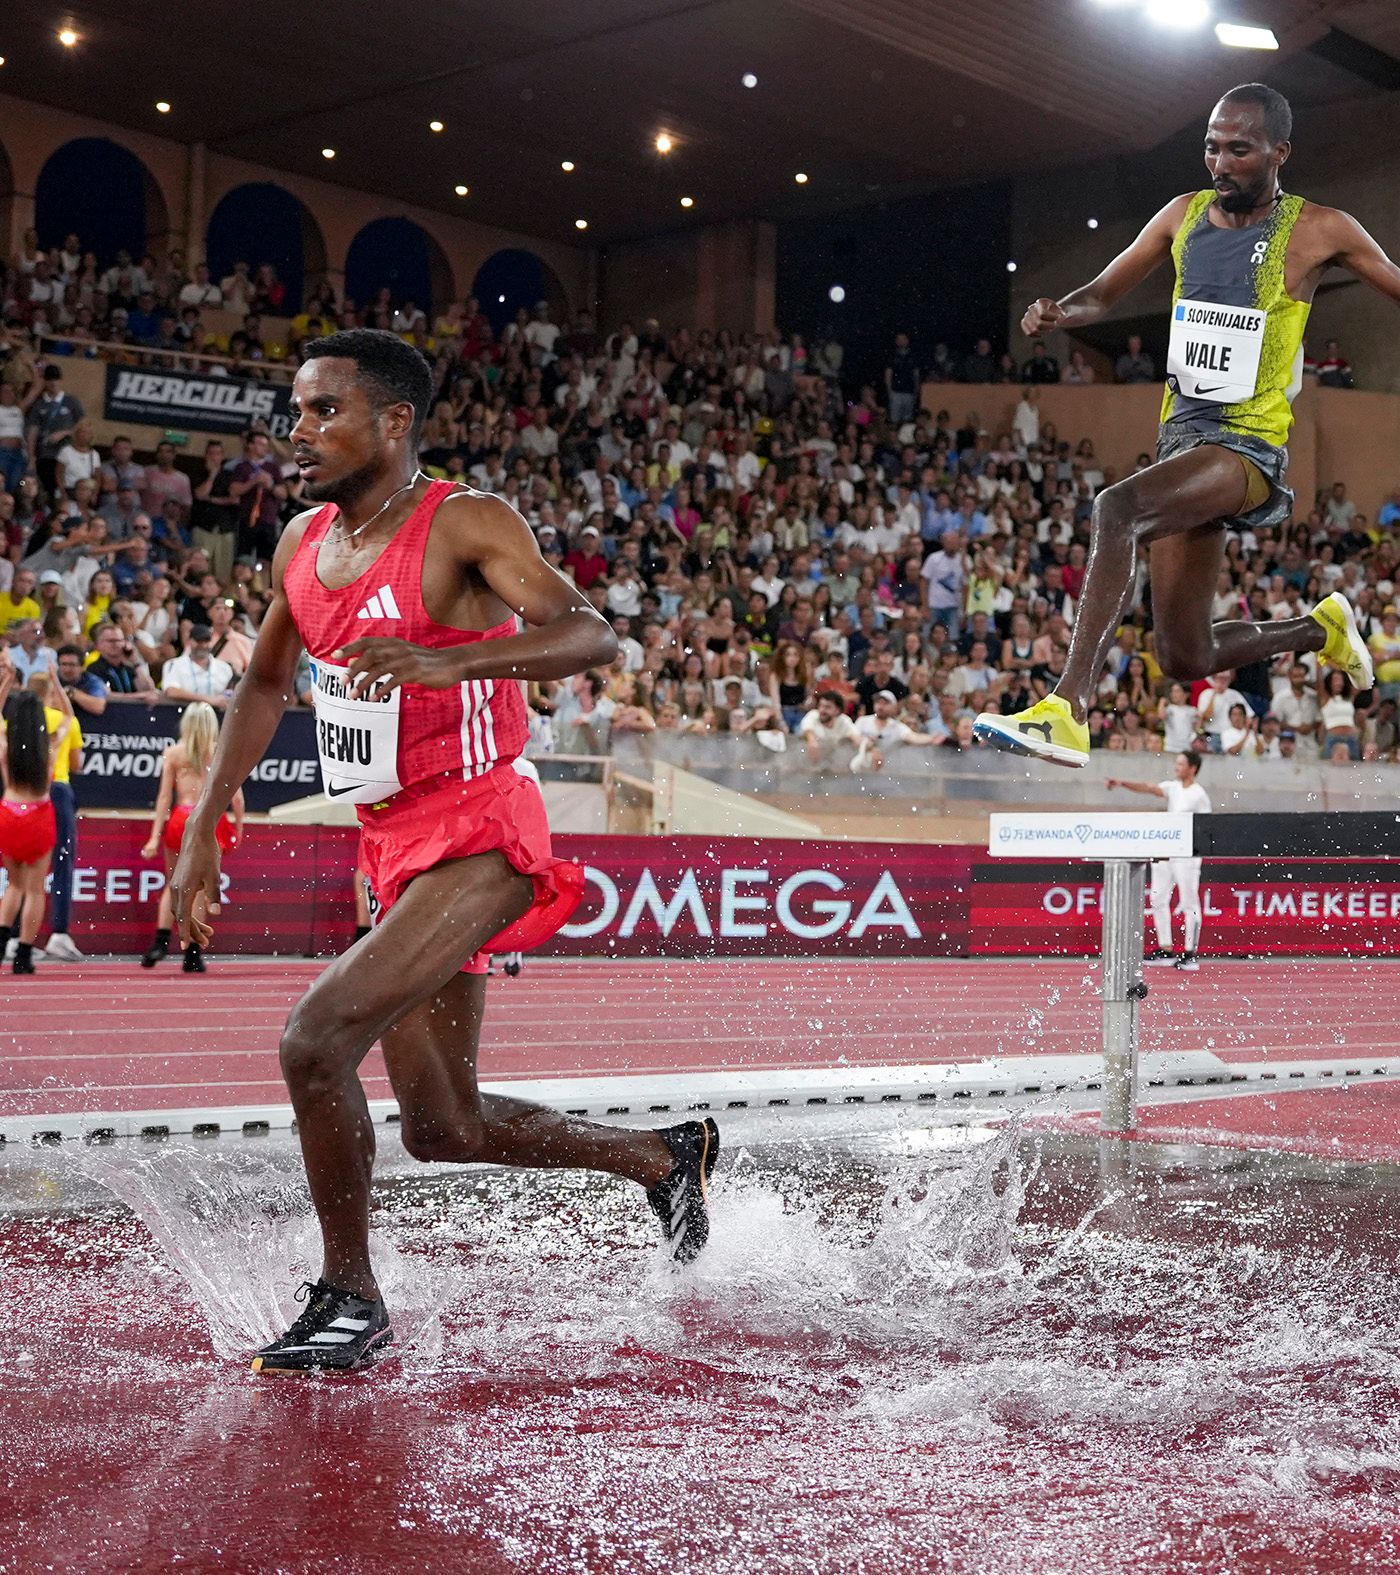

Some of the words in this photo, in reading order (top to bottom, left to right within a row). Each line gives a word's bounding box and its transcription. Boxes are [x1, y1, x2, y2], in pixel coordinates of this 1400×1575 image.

[1187, 308, 1261, 331] SLOVENIJALES
[1185, 340, 1232, 372] WALE
[112, 371, 277, 415] HERCULIS
[121, 734, 176, 751] WAND
[1036, 829, 1073, 840] WANDA
[1093, 829, 1140, 840] DIAMOND
[1142, 829, 1182, 840] LEAGUE
[555, 865, 922, 939] OMEGA
